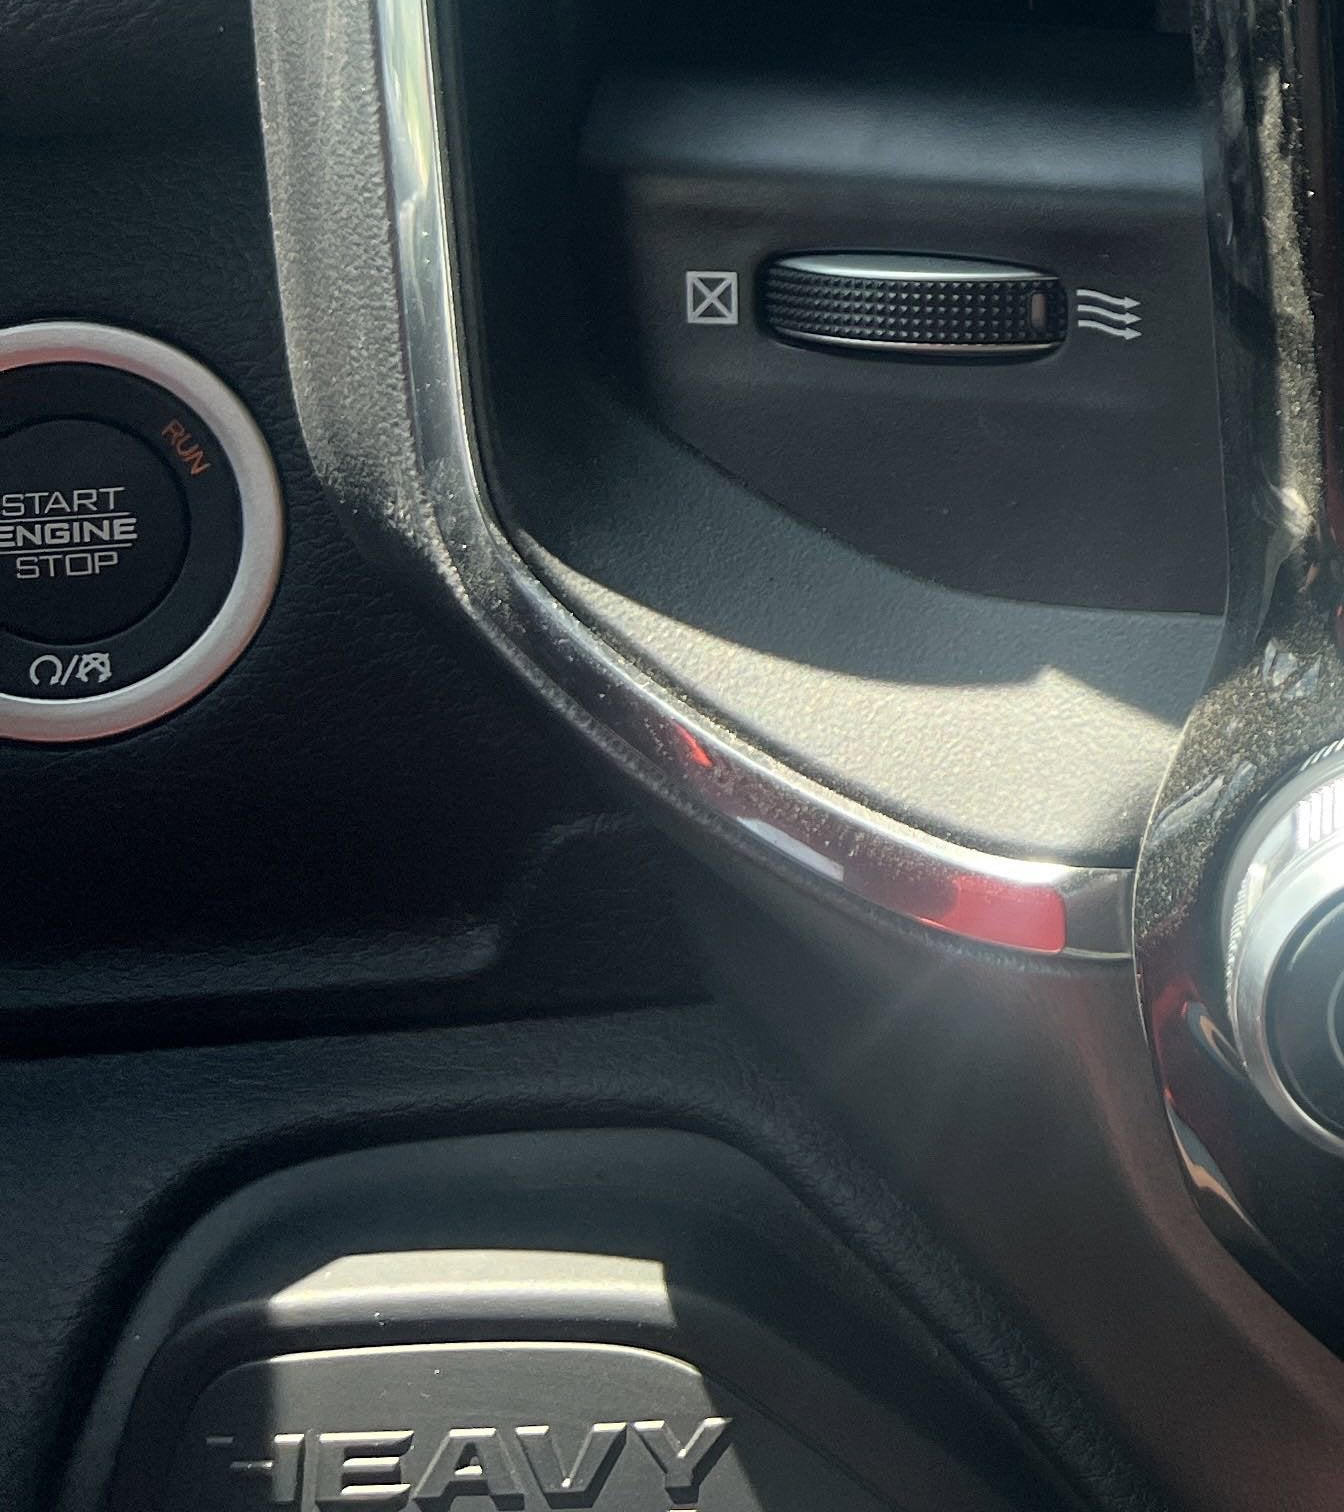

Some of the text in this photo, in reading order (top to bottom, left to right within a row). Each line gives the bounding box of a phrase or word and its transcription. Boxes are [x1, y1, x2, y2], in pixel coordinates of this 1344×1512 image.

[162, 419, 210, 476] RUN
[2, 487, 125, 516] START
[0, 518, 138, 547] ENGINE
[17, 552, 118, 579] STOP
[205, 1417, 733, 1505] HEAVY
